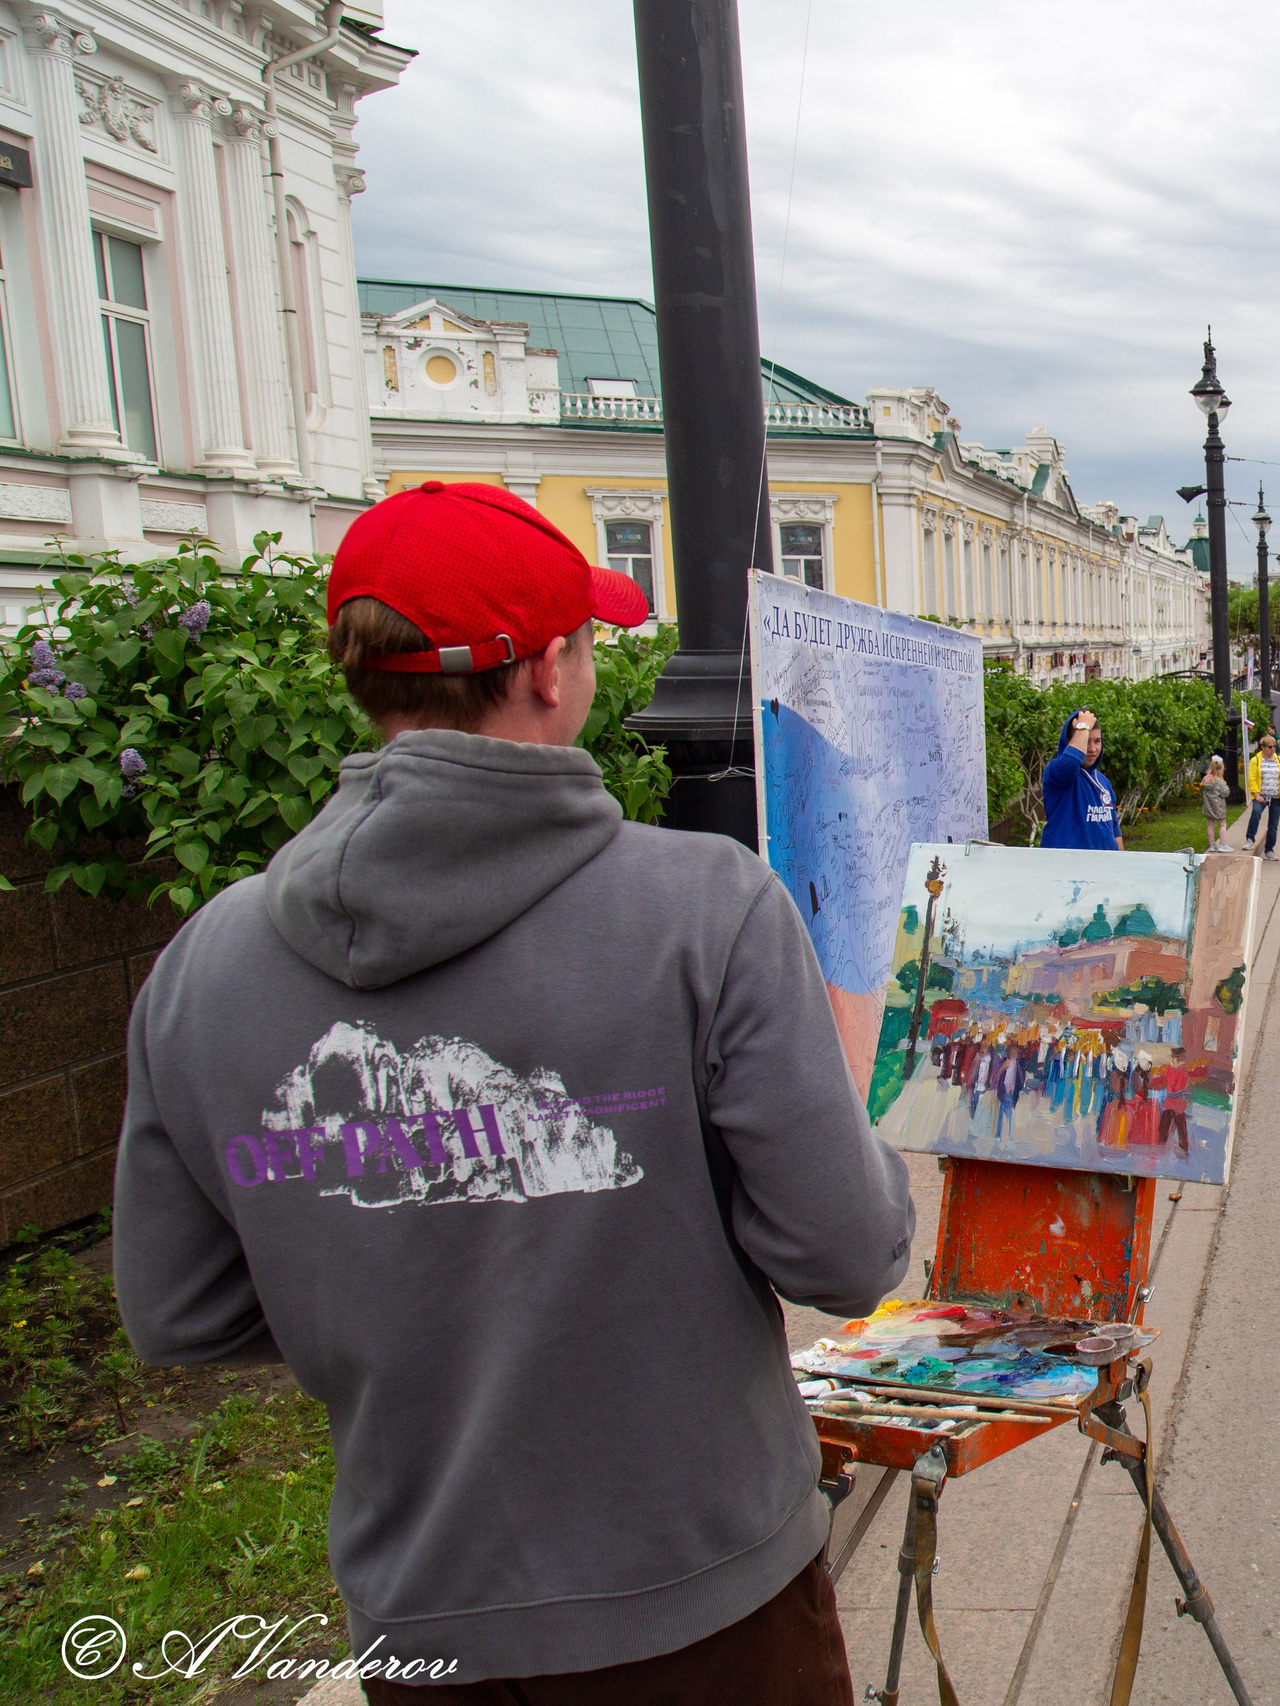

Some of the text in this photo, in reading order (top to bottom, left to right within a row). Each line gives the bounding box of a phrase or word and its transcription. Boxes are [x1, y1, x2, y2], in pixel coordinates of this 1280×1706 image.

[763, 606, 790, 642] «ДА
[794, 611, 832, 650] БУДЕТ
[836, 622, 880, 656] ДРУЖБА
[882, 633, 934, 667] ИСКРЕННЕЙ
[934, 644, 941, 668] И
[528, 1098, 666, 1122] PLANET MAGNIFICENT
[594, 1093, 620, 1102] THE
[623, 1087, 665, 1100] RIDGE
[225, 1103, 506, 1187] OFF PATH
